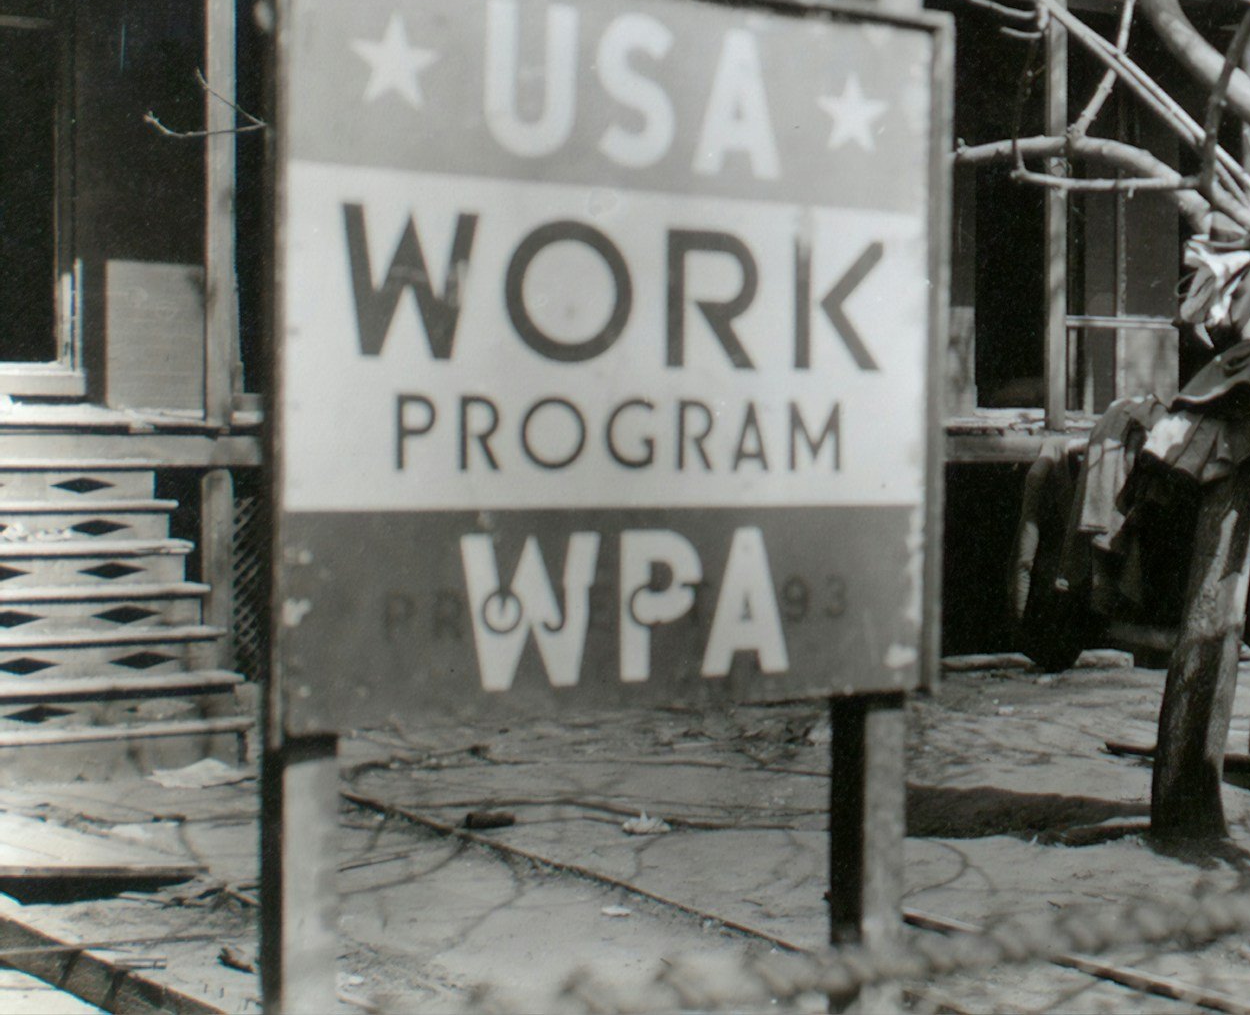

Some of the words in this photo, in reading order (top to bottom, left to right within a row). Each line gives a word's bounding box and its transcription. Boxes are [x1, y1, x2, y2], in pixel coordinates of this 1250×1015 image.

[343, 204, 884, 371] WORK
[394, 394, 843, 472] PROGRAM
[459, 526, 789, 691] WPA
